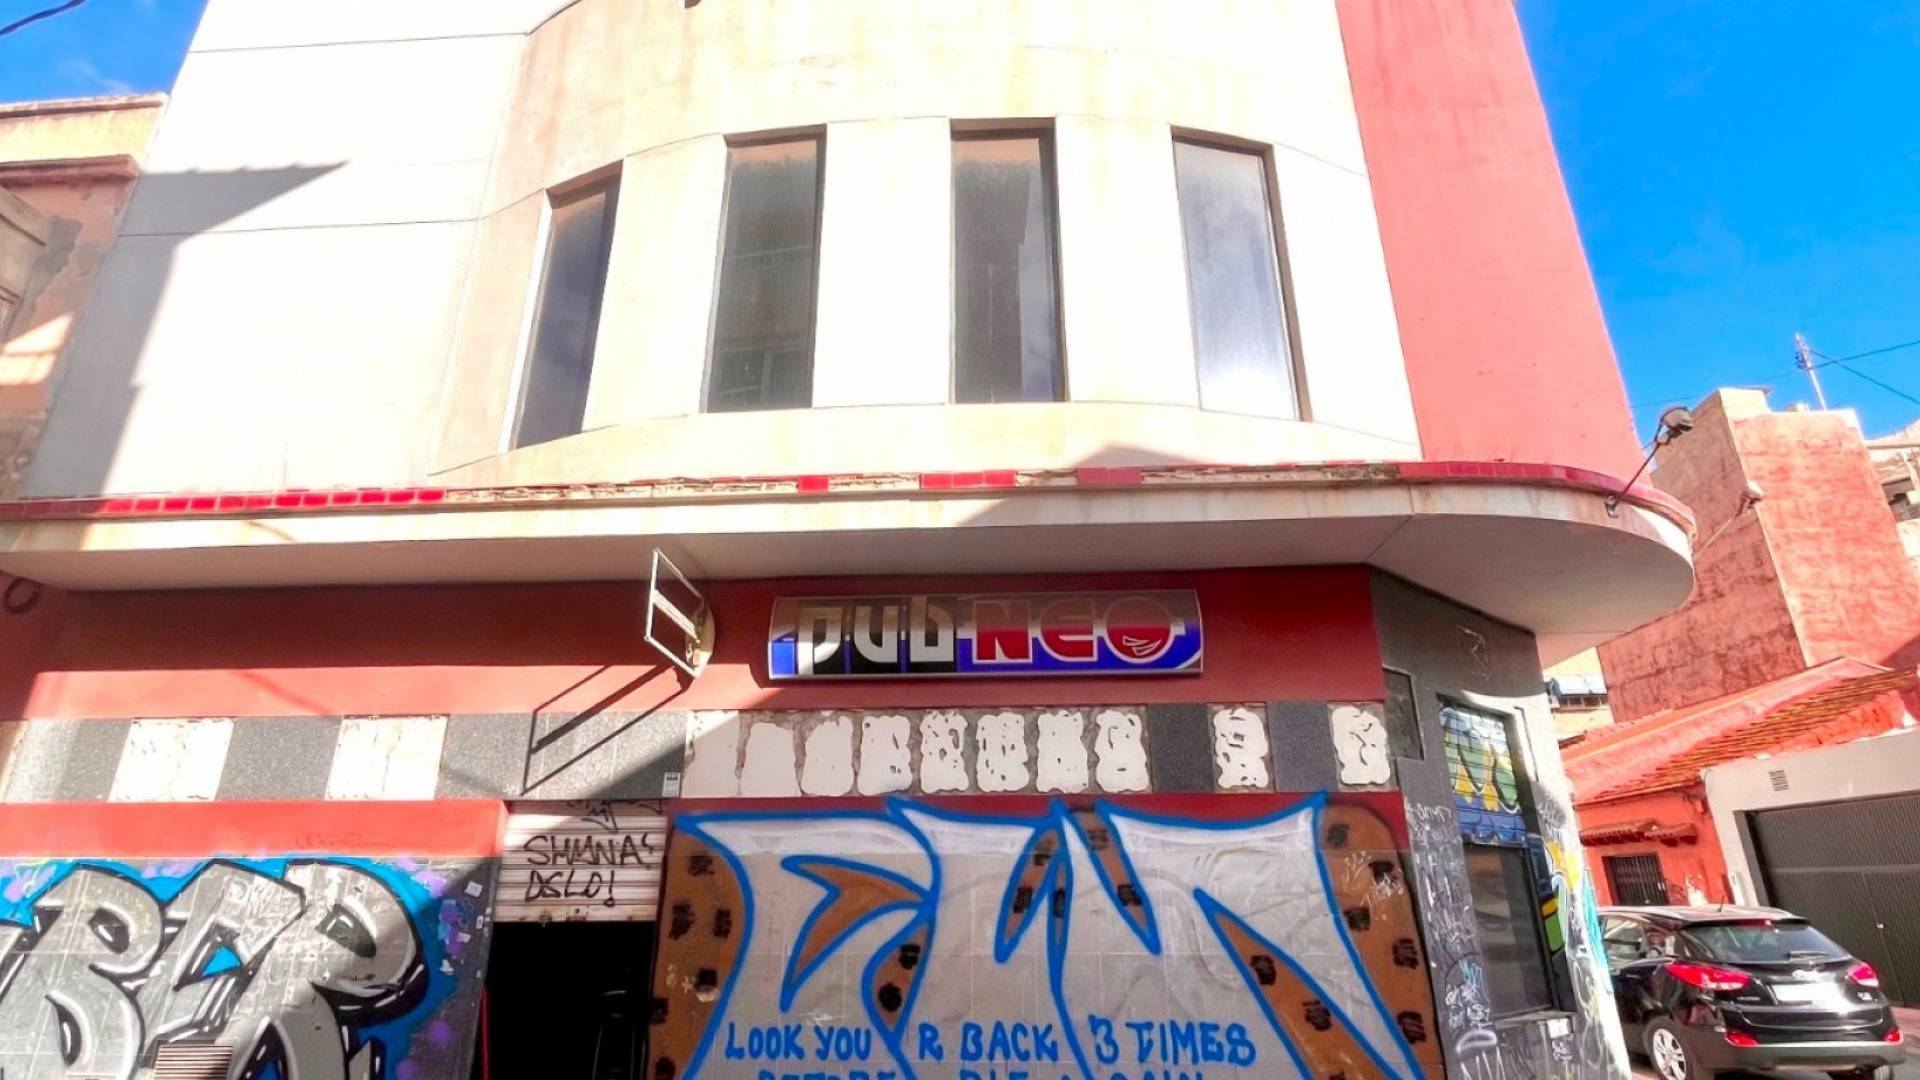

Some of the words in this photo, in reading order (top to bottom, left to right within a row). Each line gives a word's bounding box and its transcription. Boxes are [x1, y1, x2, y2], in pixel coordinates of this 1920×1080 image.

[973, 597, 1175, 664] NEO
[725, 1022, 804, 1061] LOOK
[960, 1020, 1058, 1063] BACK
[1088, 1014, 1119, 1065] 3
[1125, 1020, 1257, 1067] TIMES
